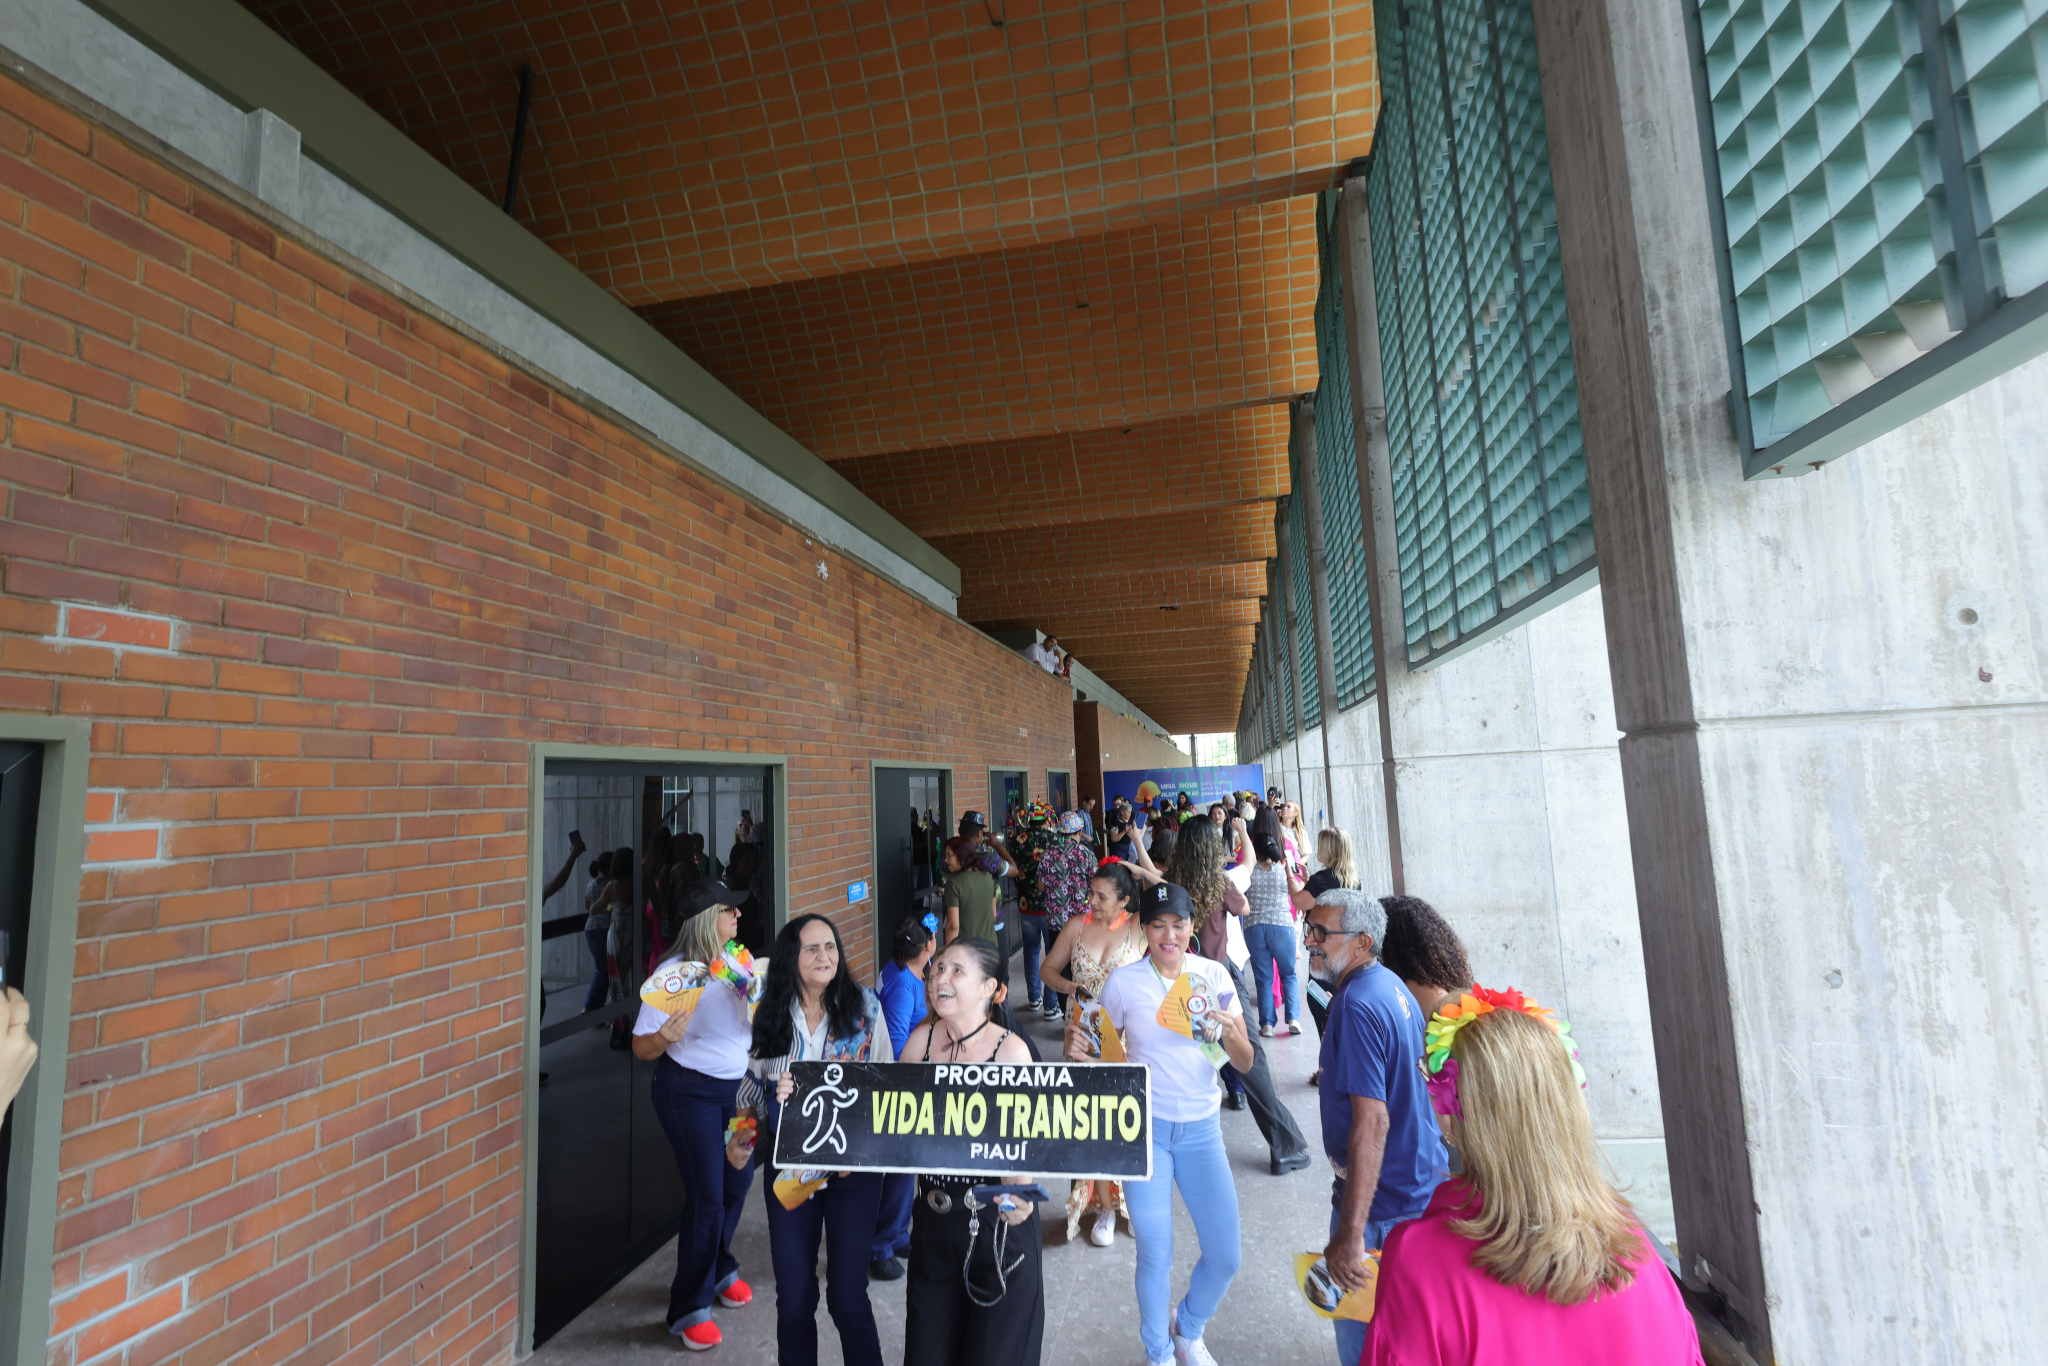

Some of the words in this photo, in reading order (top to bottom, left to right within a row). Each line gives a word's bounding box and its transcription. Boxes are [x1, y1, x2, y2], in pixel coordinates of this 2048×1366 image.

[934, 1065, 1074, 1087] PROGRAMA
[872, 1090, 935, 1135] VIDA
[943, 1092, 987, 1137] NO
[996, 1093, 1141, 1142] TRANSITO
[970, 1140, 1028, 1161] PIAUÍ
